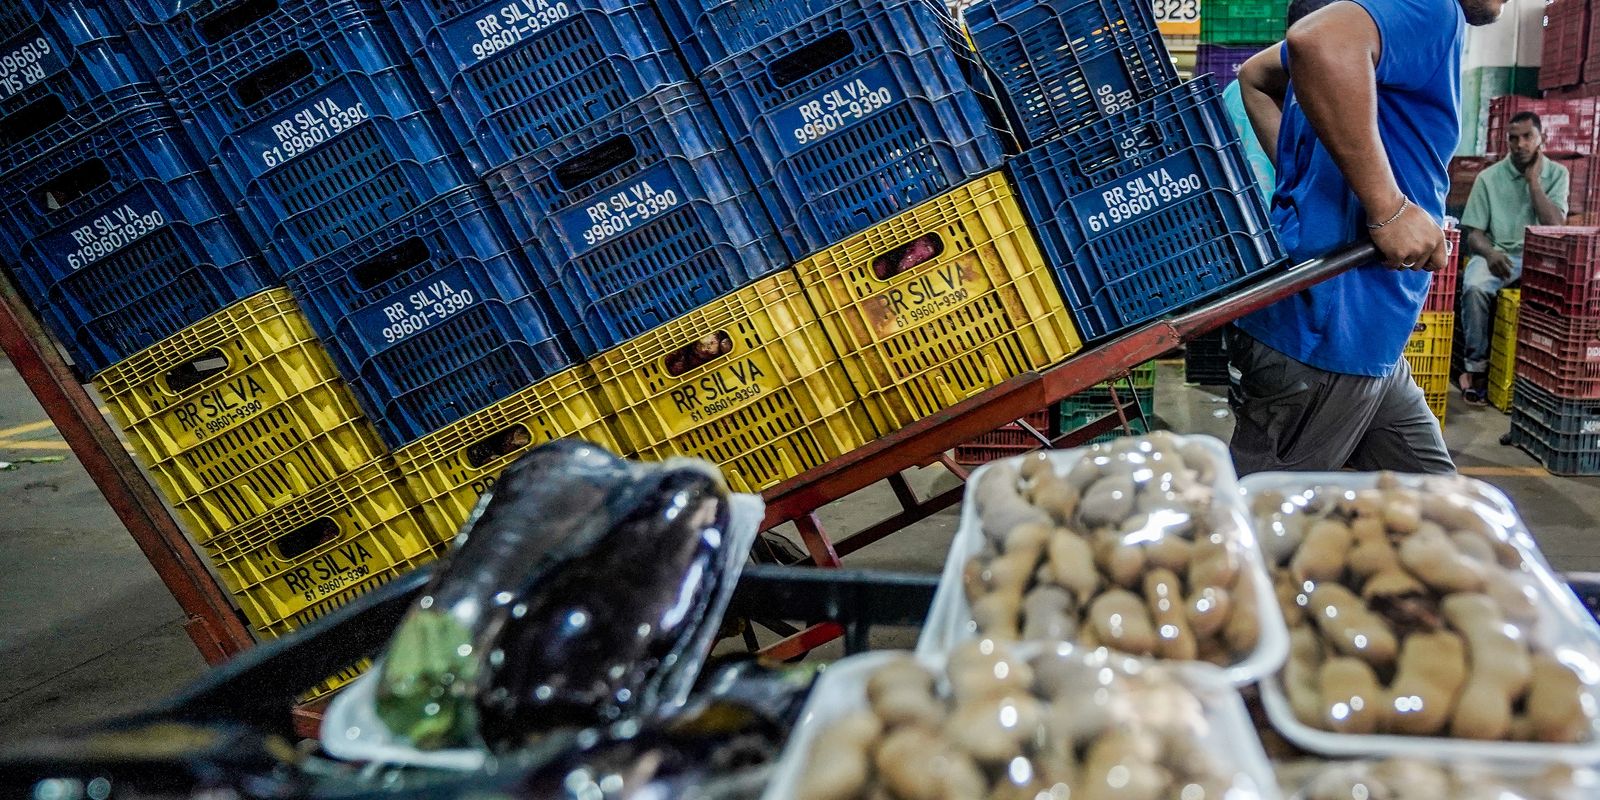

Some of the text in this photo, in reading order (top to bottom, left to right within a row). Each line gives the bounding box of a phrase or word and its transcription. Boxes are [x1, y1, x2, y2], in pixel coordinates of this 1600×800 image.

[472, 2, 569, 60] 99601-9390
[475, 14, 502, 38] RR
[271, 97, 341, 142] RR SILVA
[794, 87, 892, 144] 99601-9390
[799, 78, 870, 122] RR SILVA
[262, 147, 283, 167] 61
[282, 123, 331, 157] 99601
[586, 181, 656, 223] RR SILVA
[1088, 174, 1201, 231] 61 99601 9390
[1102, 167, 1172, 208] RR SILVA
[70, 204, 139, 247] RR SILVA
[583, 189, 678, 245] 99601-9390
[383, 280, 454, 323] RR SILVA
[908, 262, 970, 304] SILVA
[382, 289, 473, 343] 99601-9390
[896, 288, 968, 328] 61 99601-9390
[174, 374, 265, 432] RR SILVA
[671, 358, 764, 413] RR SILVA
[691, 383, 760, 422] 61 99601-9390
[195, 399, 262, 439] 61 99601-9390
[282, 541, 372, 594] RR SILVA
[304, 564, 369, 602] 61 99601-9390
